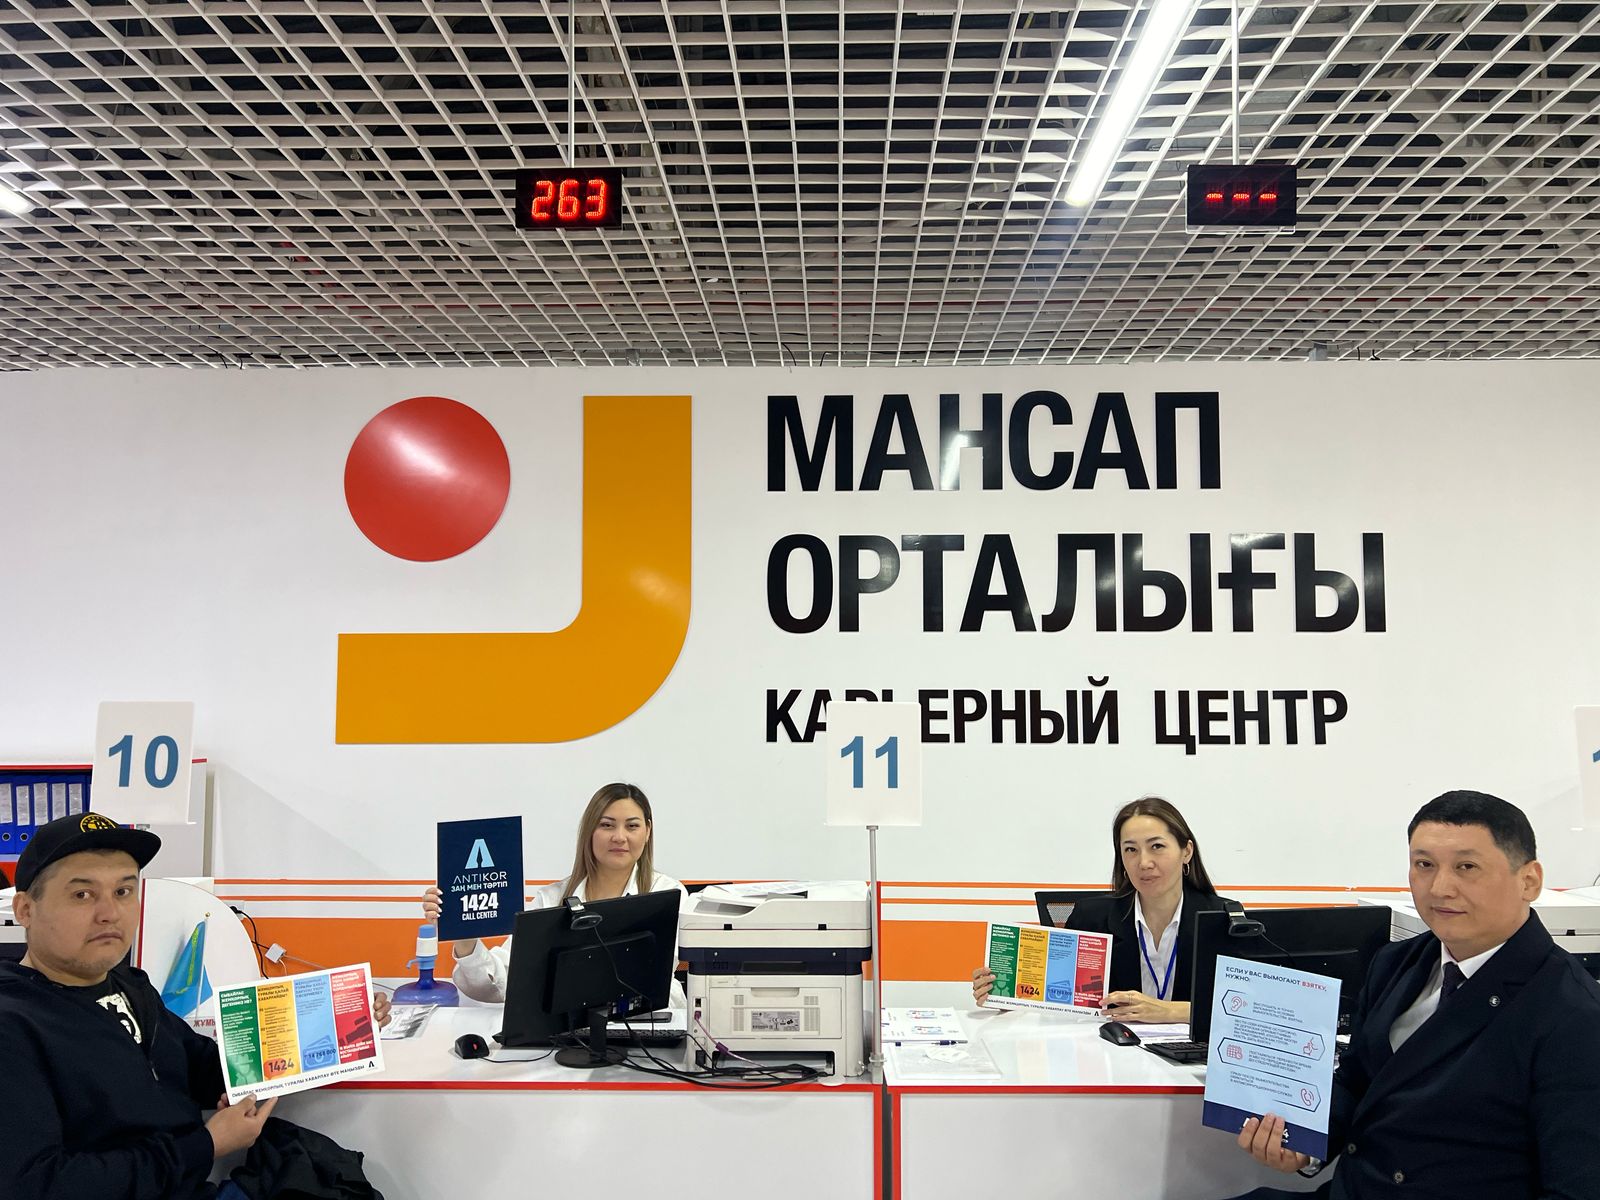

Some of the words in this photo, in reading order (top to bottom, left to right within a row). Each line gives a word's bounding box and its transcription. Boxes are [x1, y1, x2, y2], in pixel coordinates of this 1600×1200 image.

[532, 179, 606, 219] 263
[766, 390, 1222, 492] МАНСАП
[766, 531, 1387, 634] ОРТАЛЫҒЫ
[765, 676, 1120, 745] КАЕРНЫЙ
[1154, 689, 1349, 756] ЦЕНТР
[108, 735, 179, 789] 10
[841, 735, 898, 789] 11
[451, 885, 466, 893] ЗАҢ
[467, 883, 482, 891] МЕН
[483, 881, 508, 889] ТӘРТІП
[453, 871, 507, 885] ANTIKOR
[460, 892, 499, 912] 1424
[462, 912, 476, 921] CALL
[477, 910, 498, 920] CENTER
[1225, 965, 1244, 974] ЕСЛИ
[1249, 970, 1262, 978] ВАС
[1262, 972, 1300, 985] ВЫМОГАЮТ
[1020, 985, 1040, 996] 1424
[267, 1057, 295, 1073] 1424
